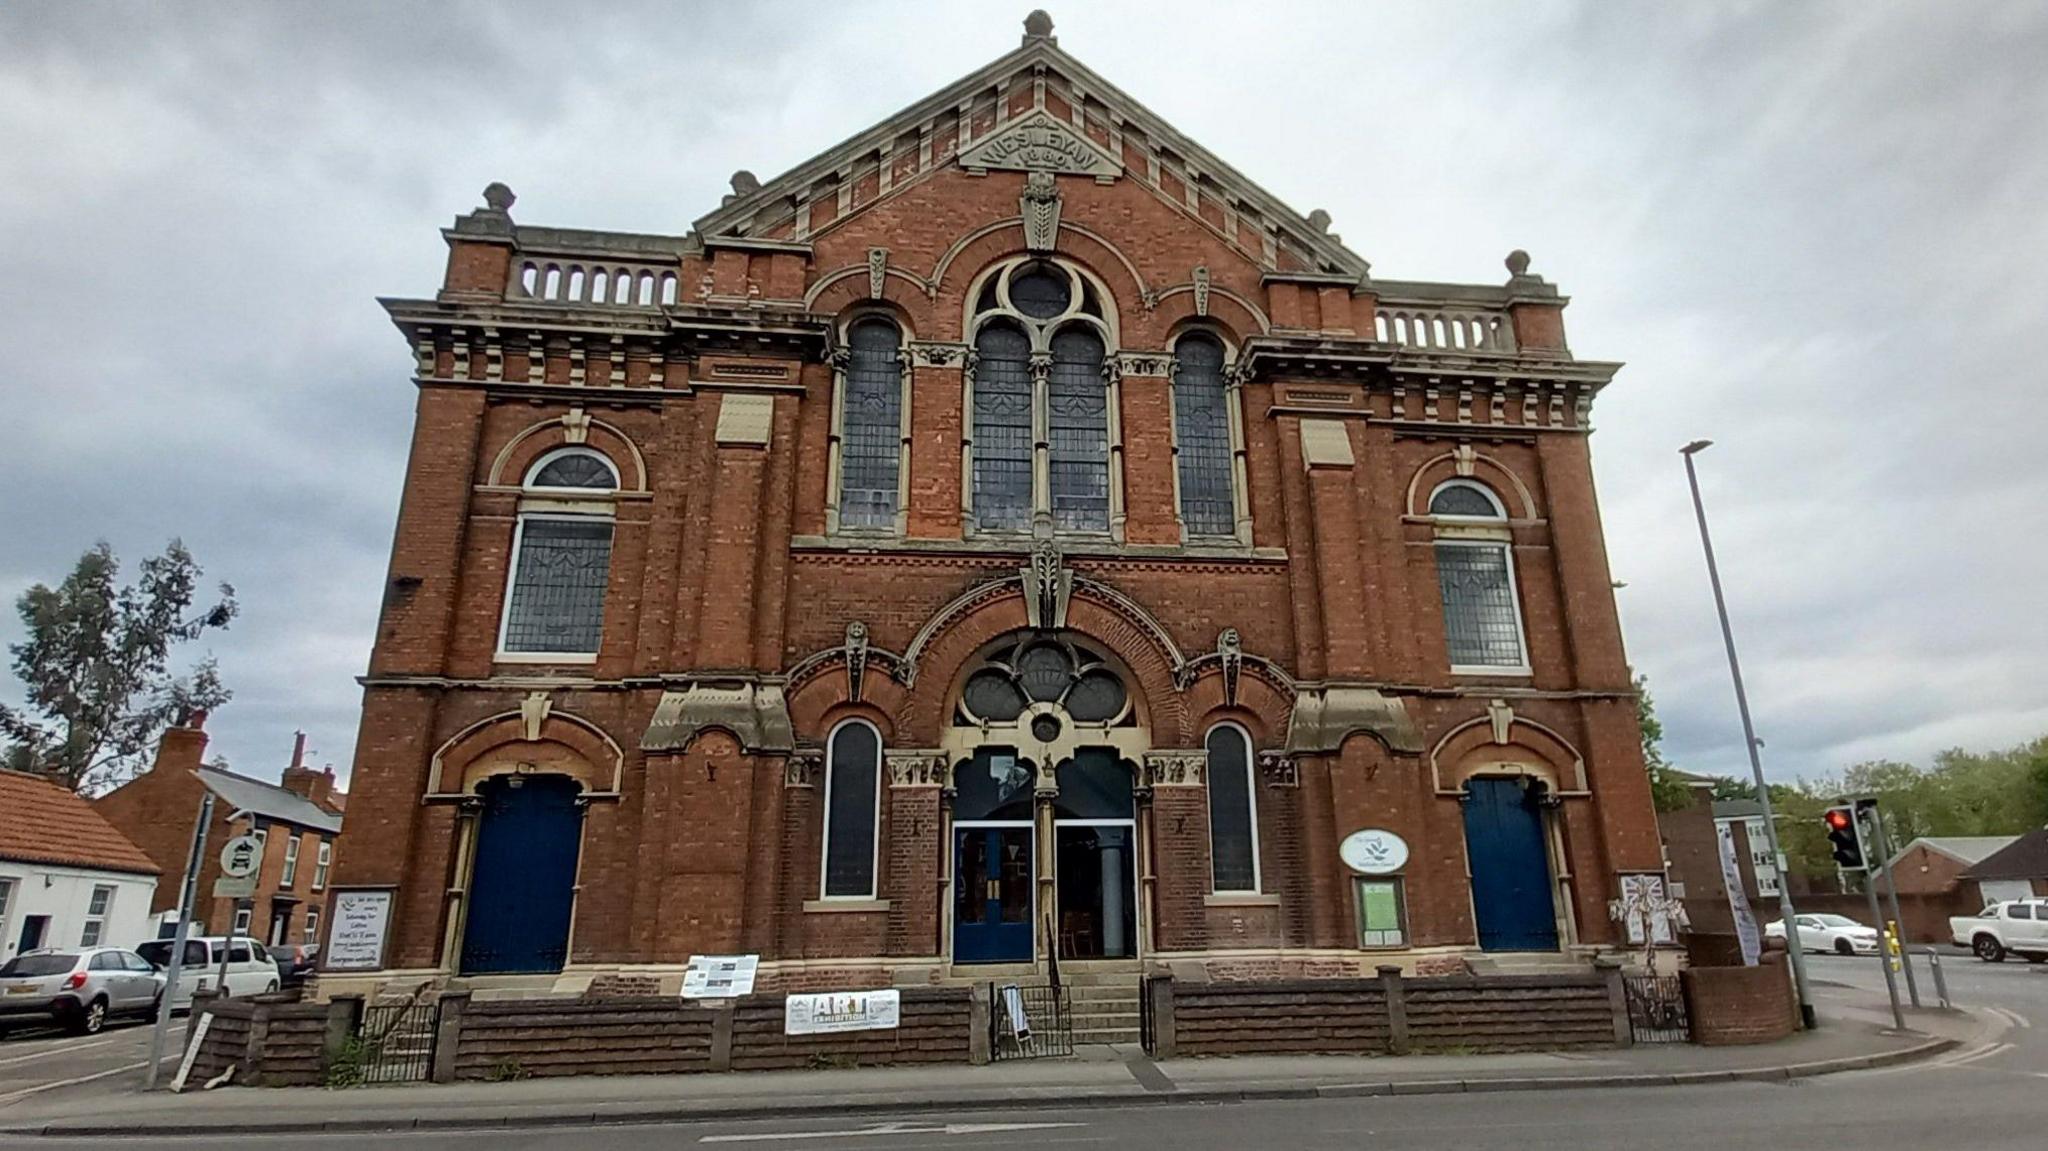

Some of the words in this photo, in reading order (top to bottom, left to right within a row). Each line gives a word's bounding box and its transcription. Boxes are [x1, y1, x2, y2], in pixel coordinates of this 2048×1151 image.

[980, 130, 1098, 170] WESLEYAN
[1018, 149, 1066, 166] 1880
[814, 997, 866, 1015] ART
[813, 1014, 866, 1023] EXHIBITION
